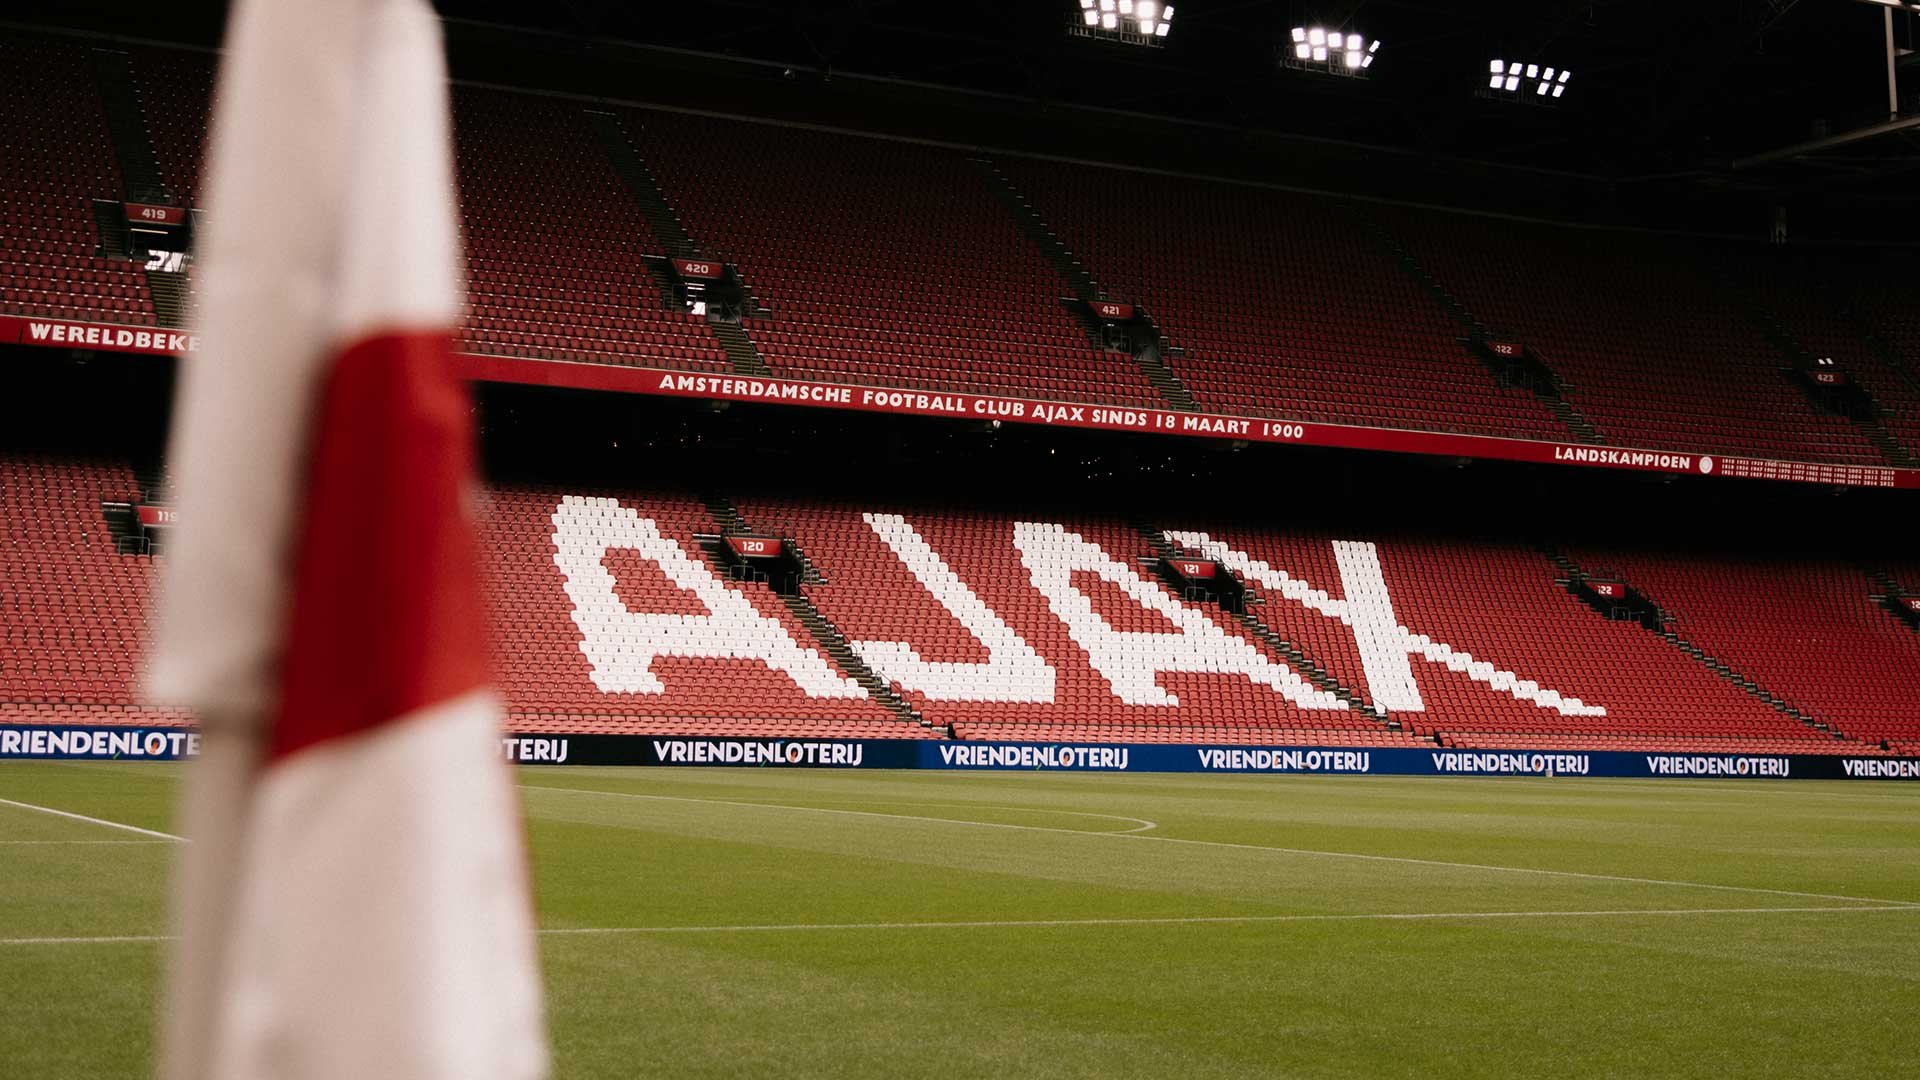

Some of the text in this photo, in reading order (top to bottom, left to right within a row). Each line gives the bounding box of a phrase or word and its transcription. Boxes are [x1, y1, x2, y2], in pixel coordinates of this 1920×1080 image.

[142, 208, 166, 220] 419
[685, 263, 709, 274] 420
[1102, 305, 1120, 315] 421
[659, 374, 1304, 438] AMSTERDAMSCHE FOOTBALL CLUB AJAX SINDS 18 MAART 1900
[1555, 446, 1691, 469] LANDSKAMPIOEN
[742, 540, 765, 552] 120
[1184, 563, 1199, 574] 121
[552, 495, 1607, 717] AJAX
[0, 730, 201, 755] RIENDENLOTE
[653, 740, 863, 768] VRIENDENLOTERIJ
[938, 744, 1129, 770] VRIENDENLOTERIJ
[1198, 747, 1370, 772] VRIENDENLOTERIJ
[1432, 751, 1590, 776] VRIENDENLOTERIJ
[1646, 755, 1790, 777] VRIENDENLOTERIJ
